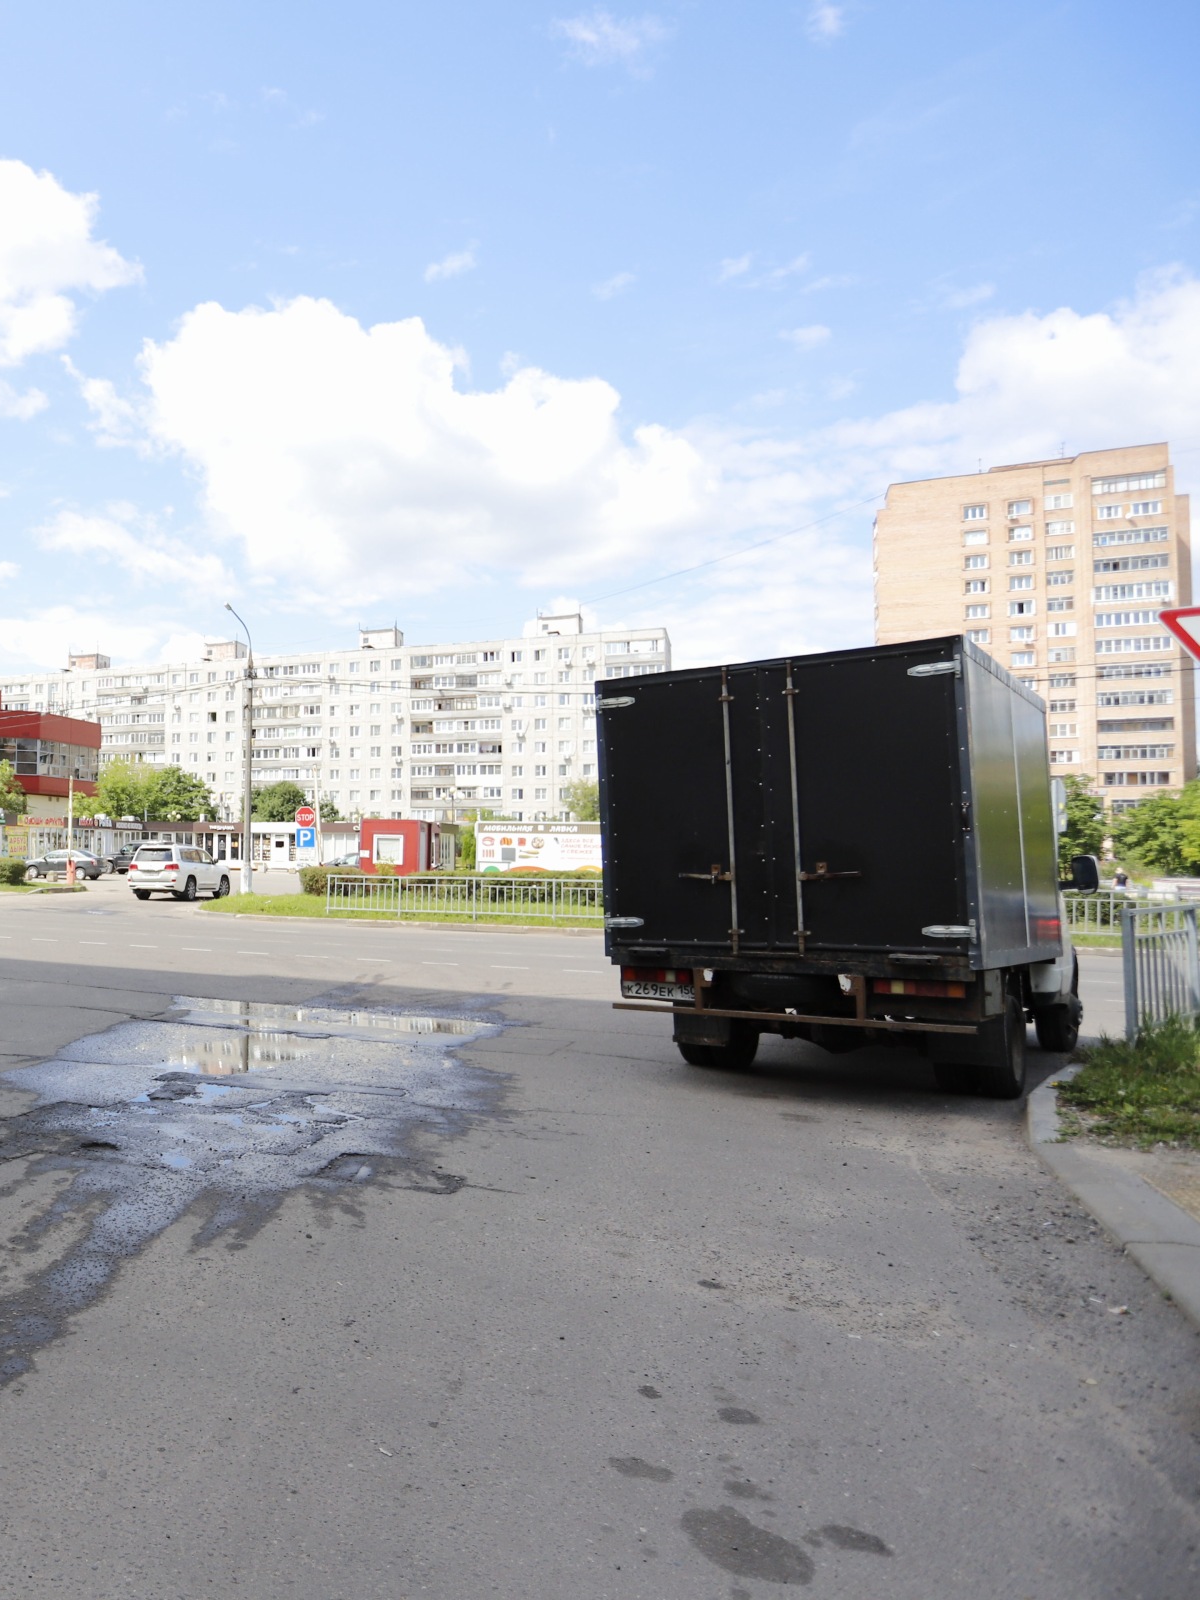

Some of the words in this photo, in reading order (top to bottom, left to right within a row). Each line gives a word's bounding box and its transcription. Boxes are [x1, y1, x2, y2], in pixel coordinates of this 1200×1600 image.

[296, 813, 314, 822] STOP
[483, 825, 534, 833] МОБИЛЬНАЯ
[549, 825, 578, 833] ЛАВКА
[299, 829, 311, 847] P
[627, 982, 675, 997] К269ЕК
[677, 984, 695, 995] 150
